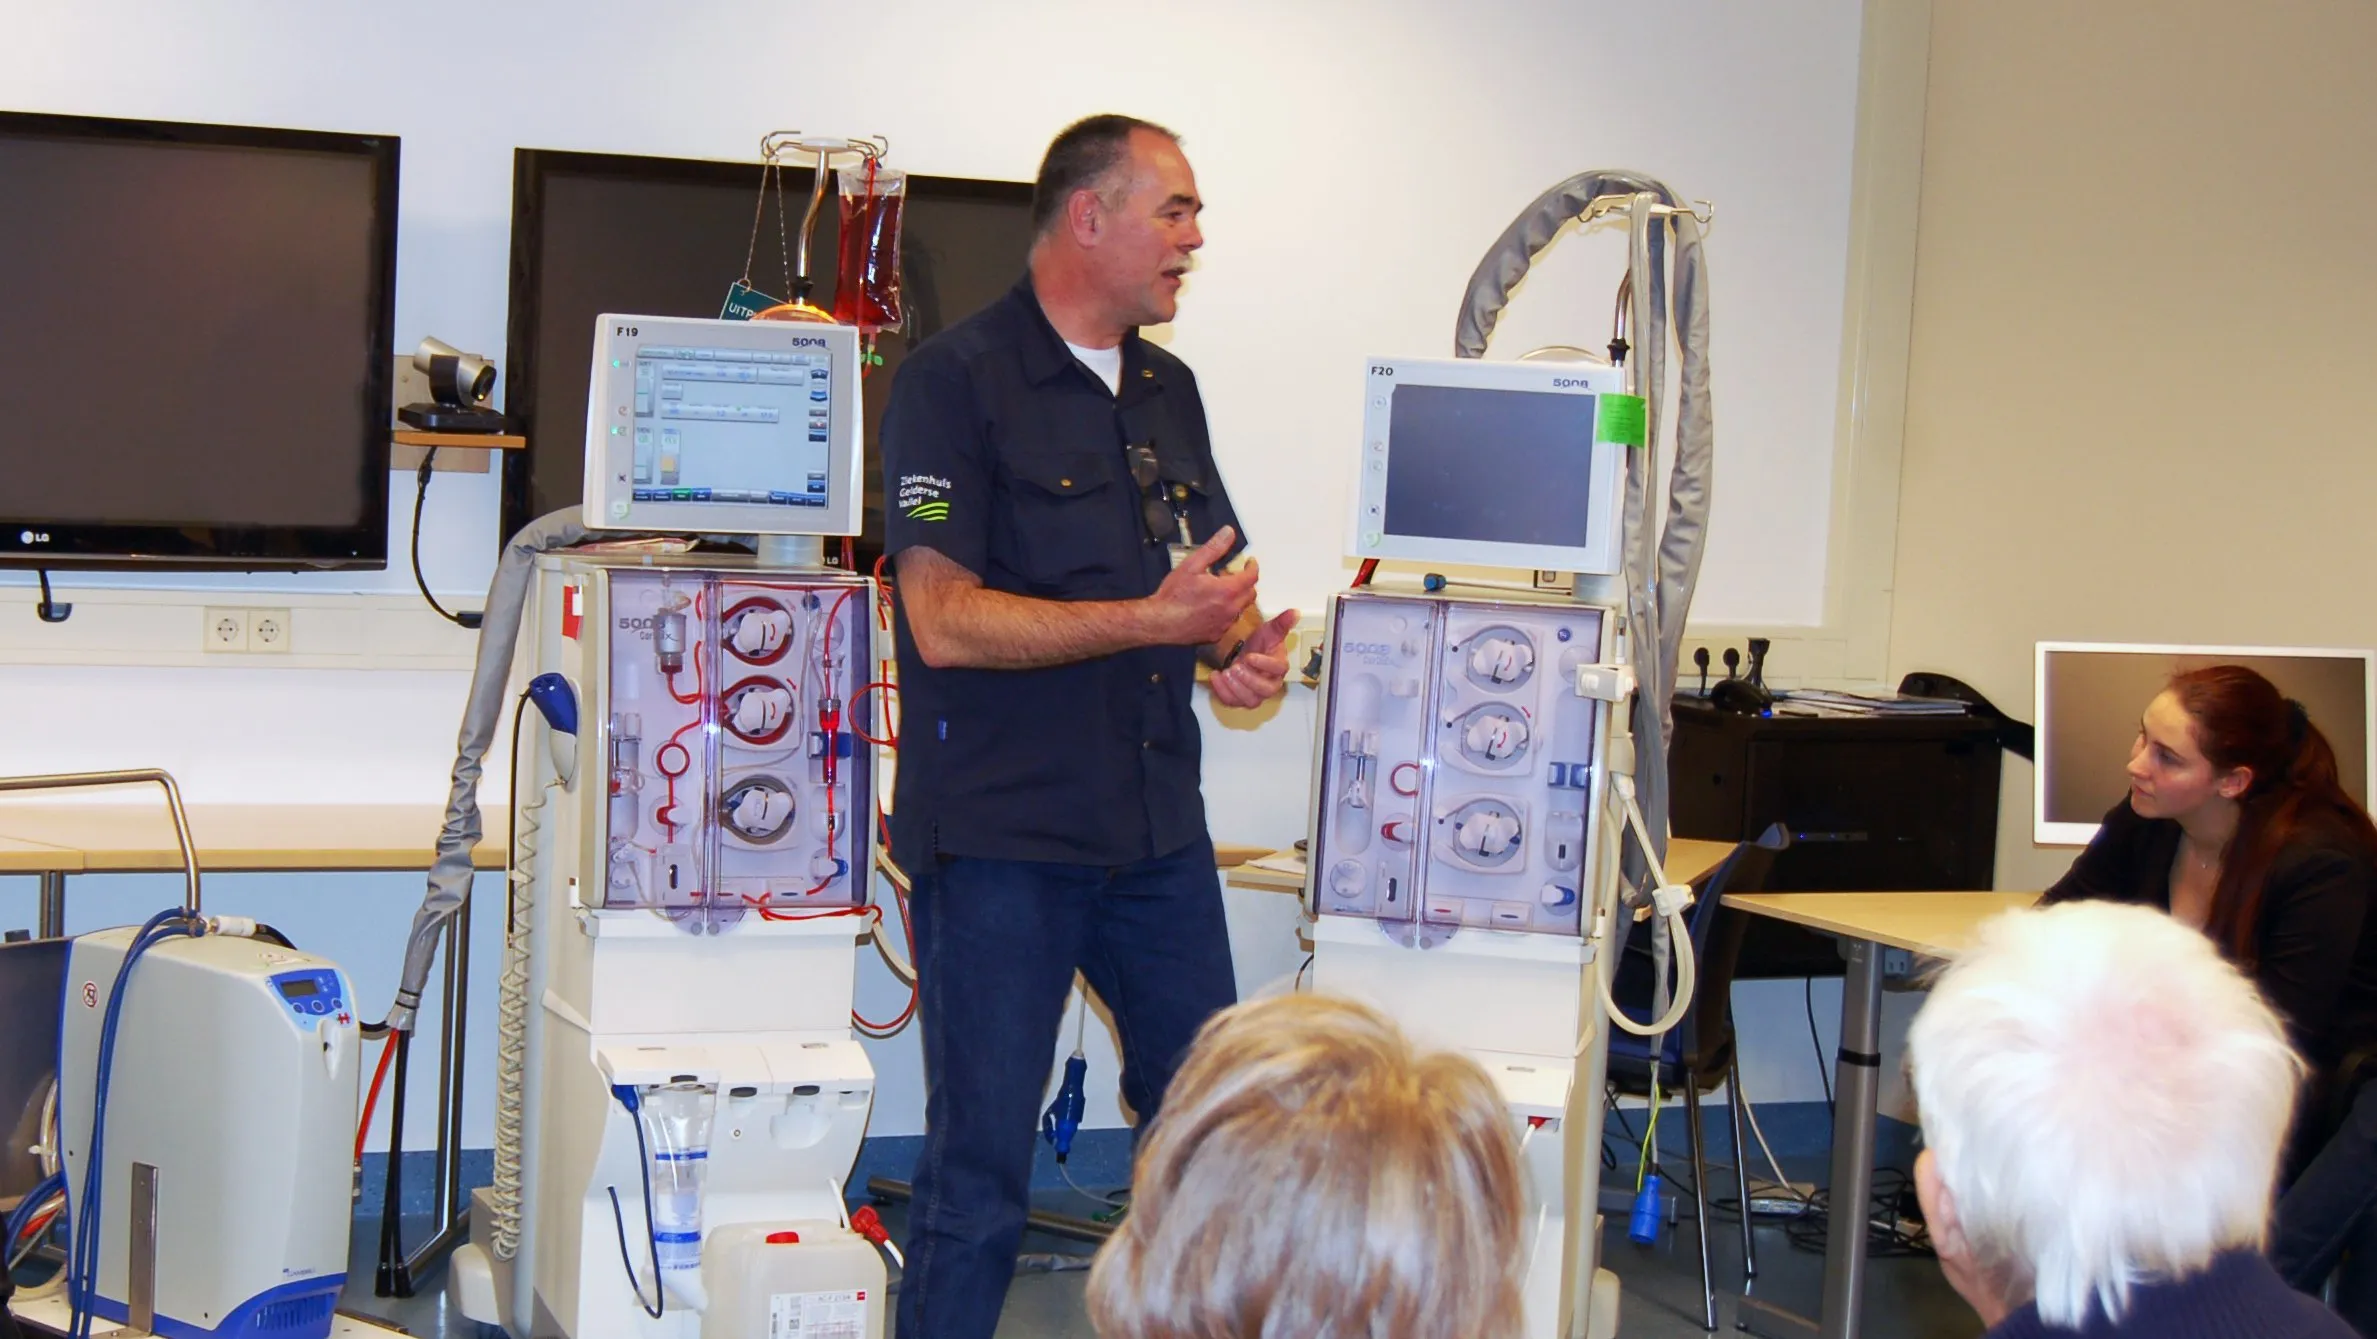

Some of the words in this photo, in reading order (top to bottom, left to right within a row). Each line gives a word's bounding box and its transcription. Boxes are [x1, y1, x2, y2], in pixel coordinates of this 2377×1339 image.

[616, 326, 639, 337] F19
[1371, 365, 1394, 376] F20
[35, 533, 50, 542] LG
[826, 556, 839, 565] LG
